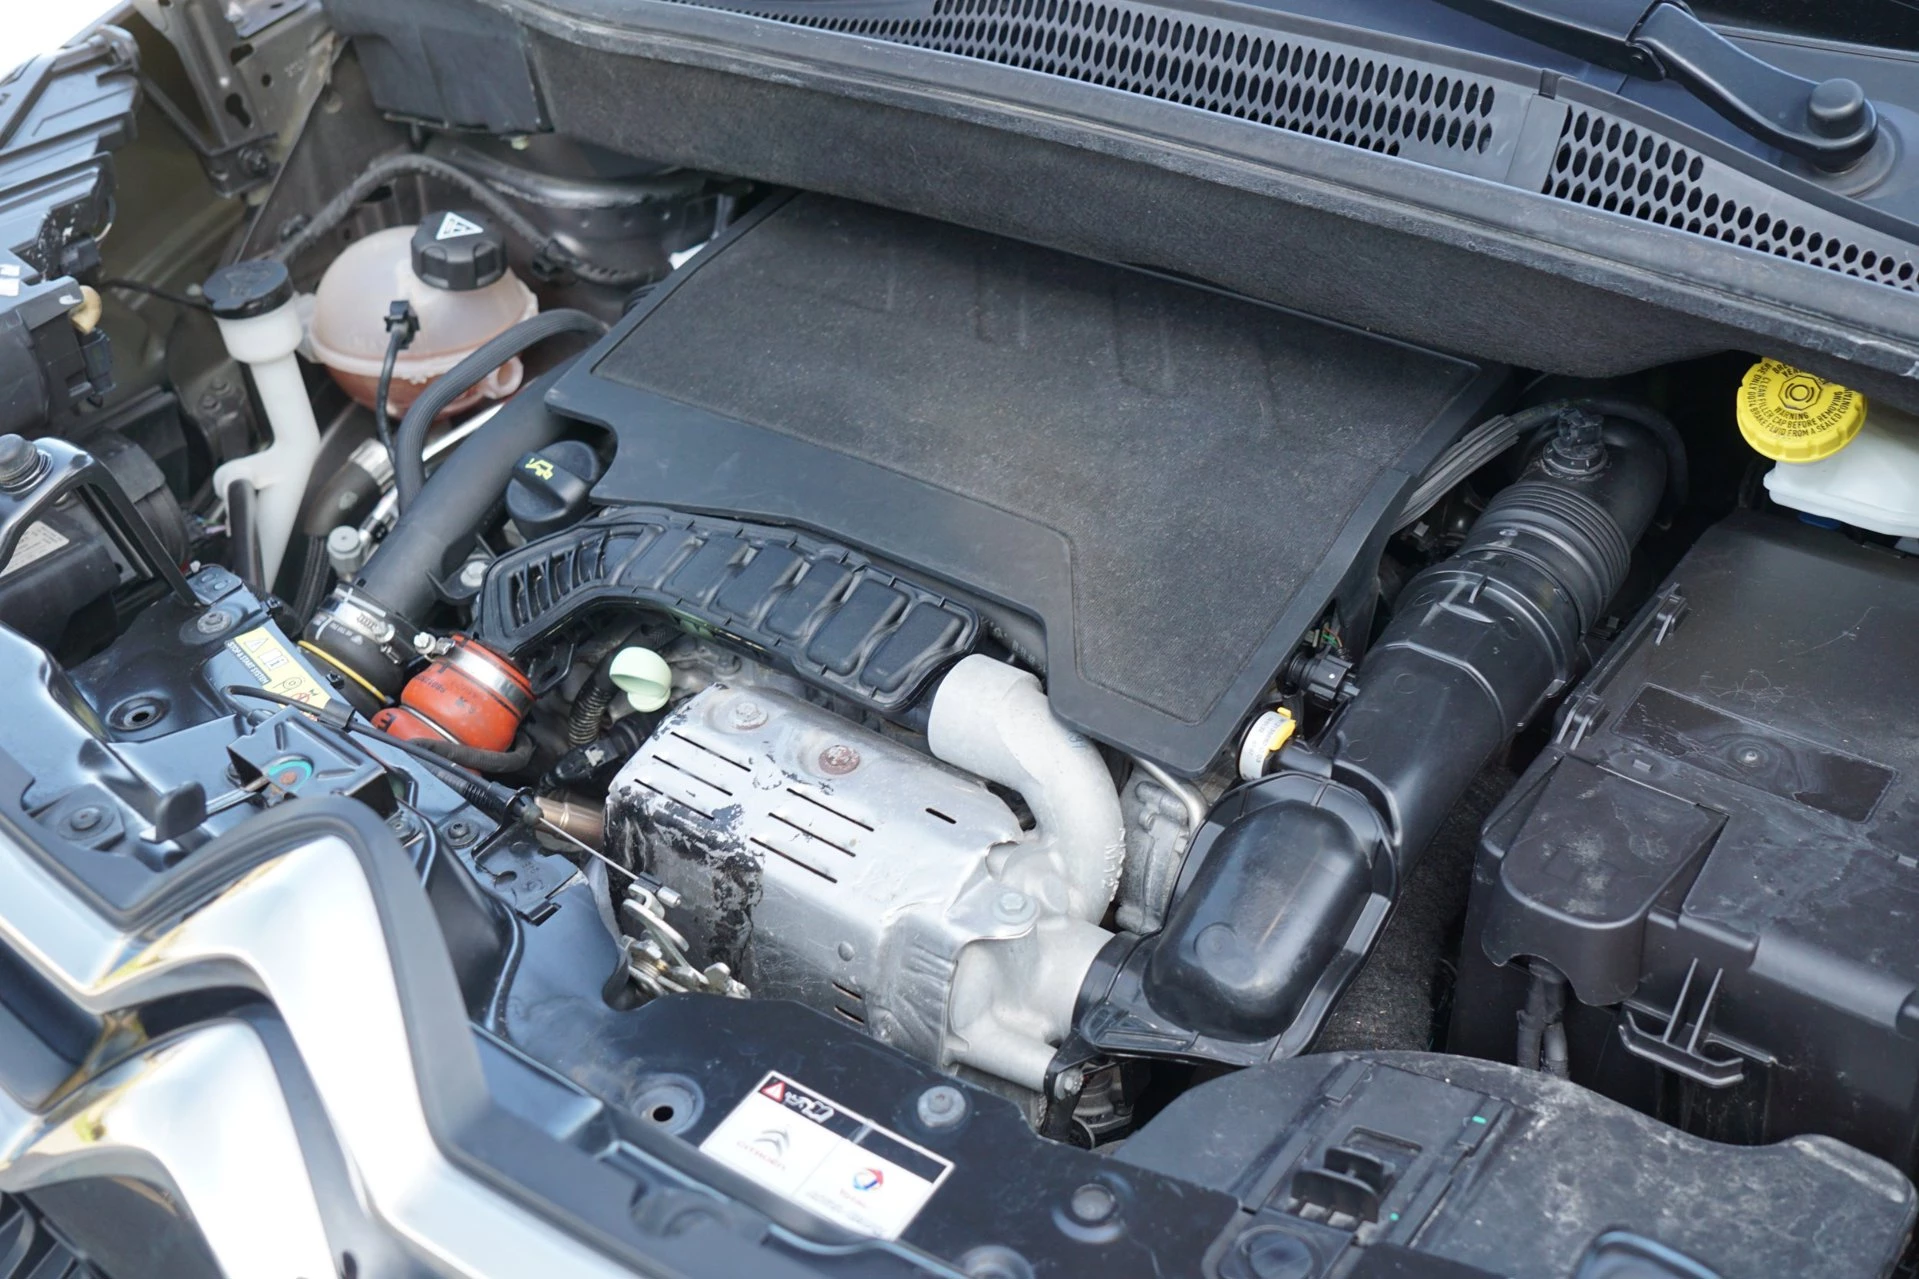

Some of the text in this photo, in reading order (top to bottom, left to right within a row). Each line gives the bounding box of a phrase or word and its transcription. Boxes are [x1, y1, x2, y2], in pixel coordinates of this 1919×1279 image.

[1749, 374, 1762, 391] ONLY
[1757, 377, 1843, 429] CLEAN FILLER CAP BEFORE REMOVING
[1749, 407, 1768, 426] BRAKE
[1774, 406, 1809, 420] WARNING
[1816, 412, 1842, 433] SEALED
[1787, 428, 1809, 438] FROM
[1810, 427, 1816, 436] A
